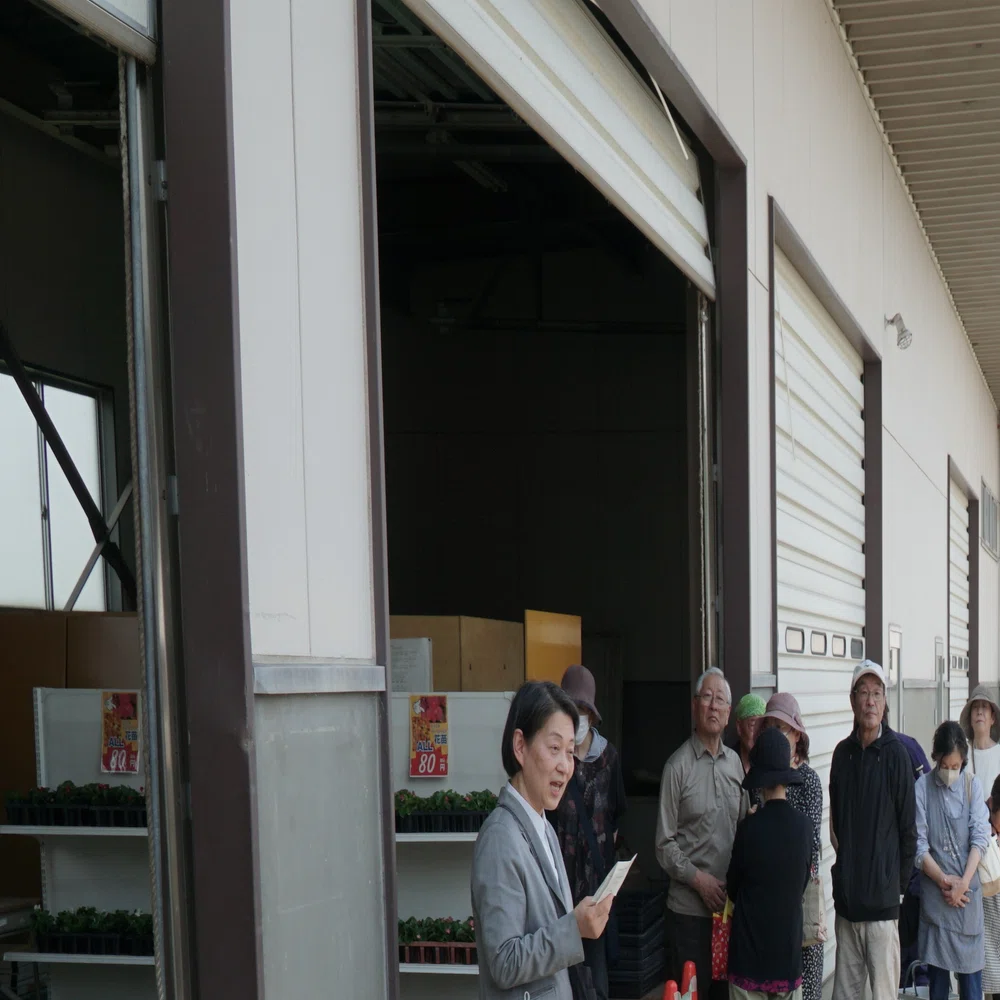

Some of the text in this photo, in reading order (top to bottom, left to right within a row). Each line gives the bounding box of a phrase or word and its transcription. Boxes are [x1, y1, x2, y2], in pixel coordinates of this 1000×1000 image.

[108, 737, 125, 748] ALL
[416, 740, 434, 752] ALL
[418, 753, 436, 773] 80
